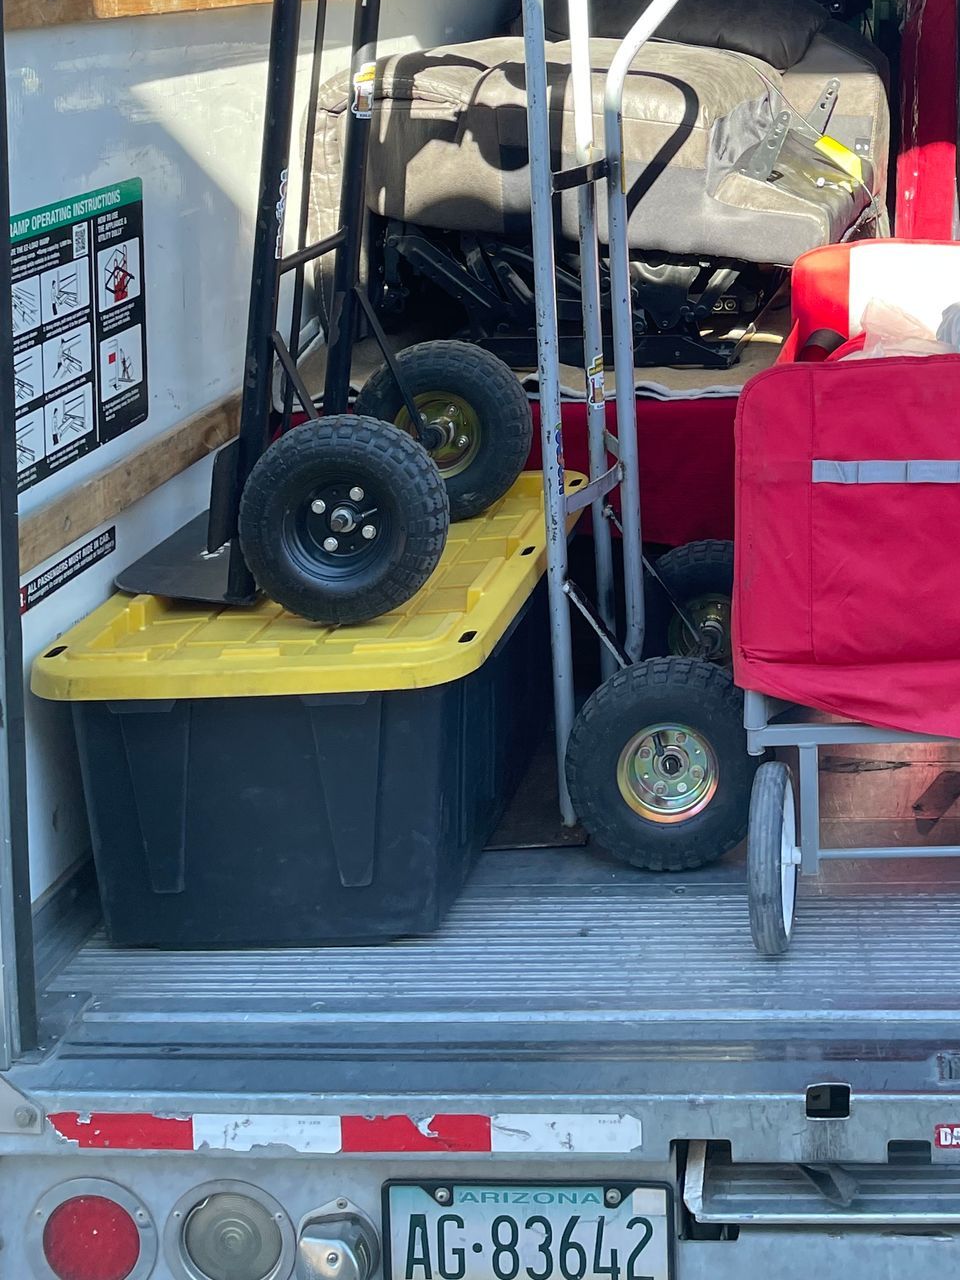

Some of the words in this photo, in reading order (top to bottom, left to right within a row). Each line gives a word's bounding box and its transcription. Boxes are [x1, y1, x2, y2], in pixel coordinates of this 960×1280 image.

[31, 205, 72, 230] OPERATING
[73, 190, 120, 217] INSTRUCTIONS
[27, 582, 37, 595] ALL
[37, 559, 69, 587] PASSENGERS
[68, 551, 82, 569] MUST
[82, 543, 94, 558] RIDE
[94, 538, 100, 549] IN
[459, 1191, 601, 1205] ARIZONA
